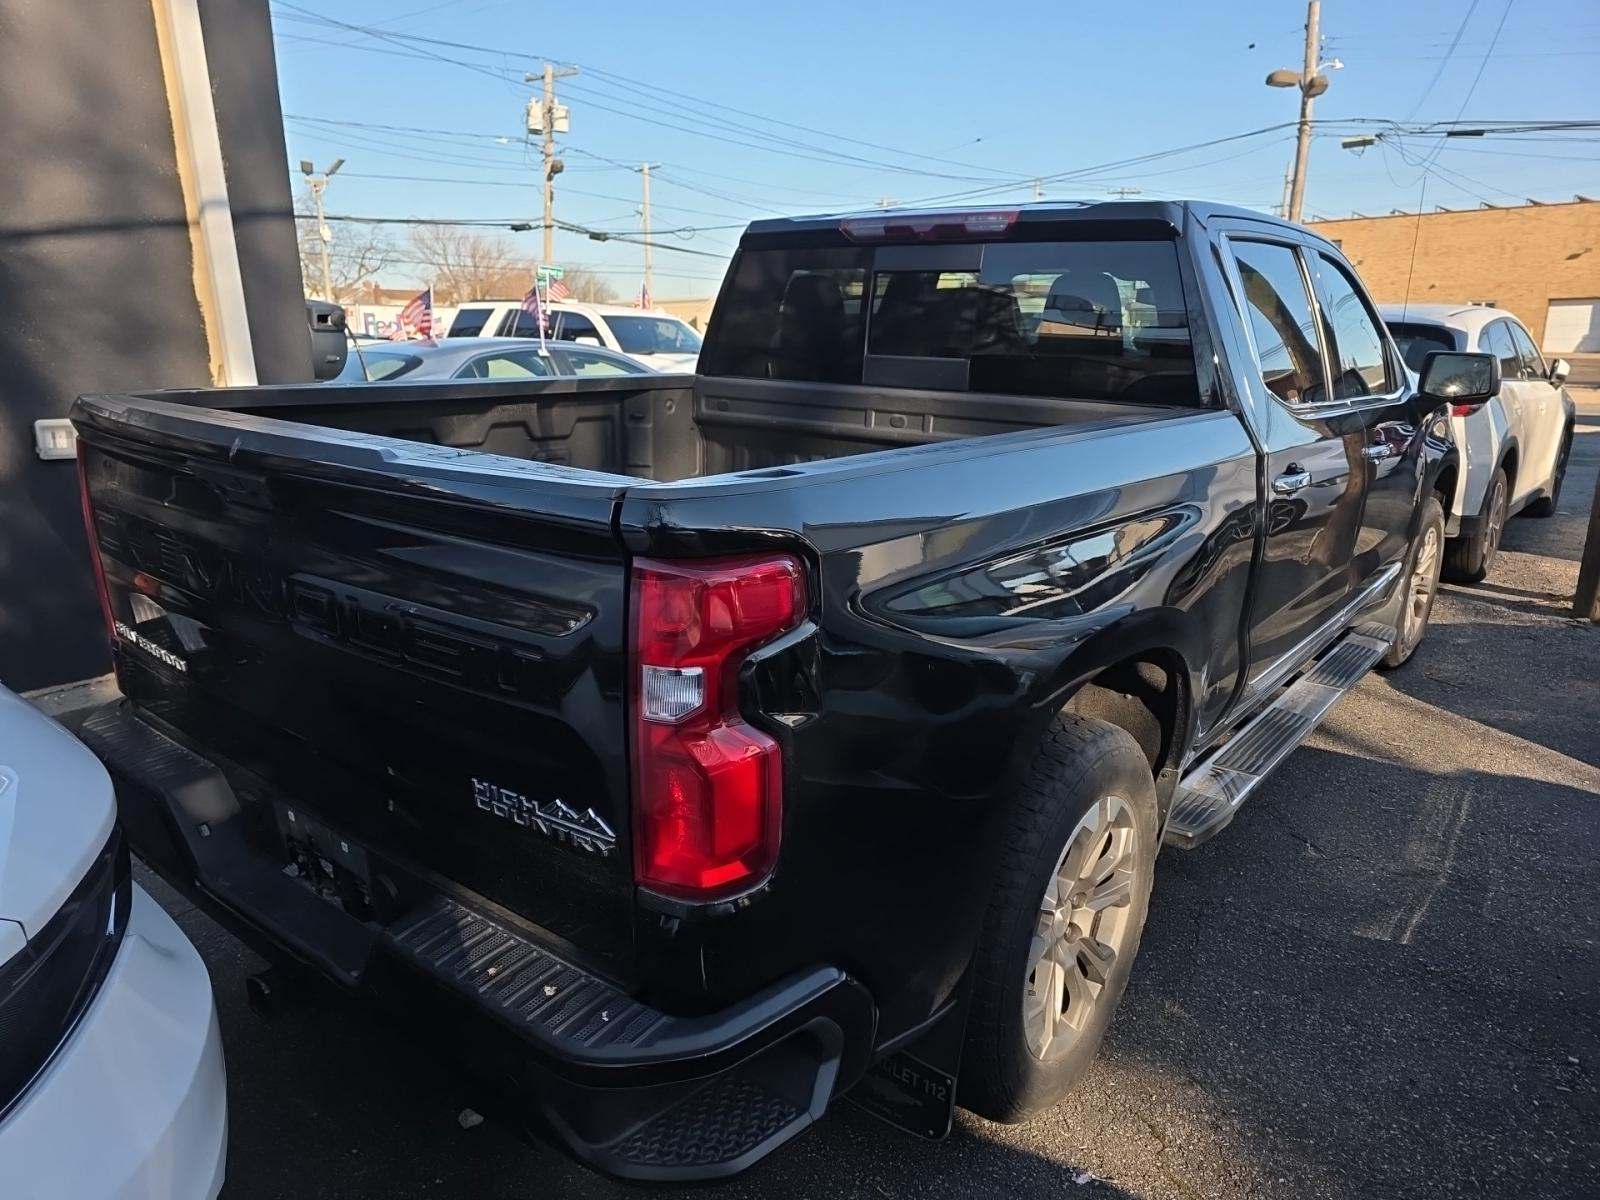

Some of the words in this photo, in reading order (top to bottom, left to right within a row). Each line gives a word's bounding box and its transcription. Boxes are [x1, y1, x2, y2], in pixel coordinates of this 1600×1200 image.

[471, 777, 541, 814] HIGH
[474, 794, 616, 857] COUNTRY
[923, 1078, 947, 1103] 112
